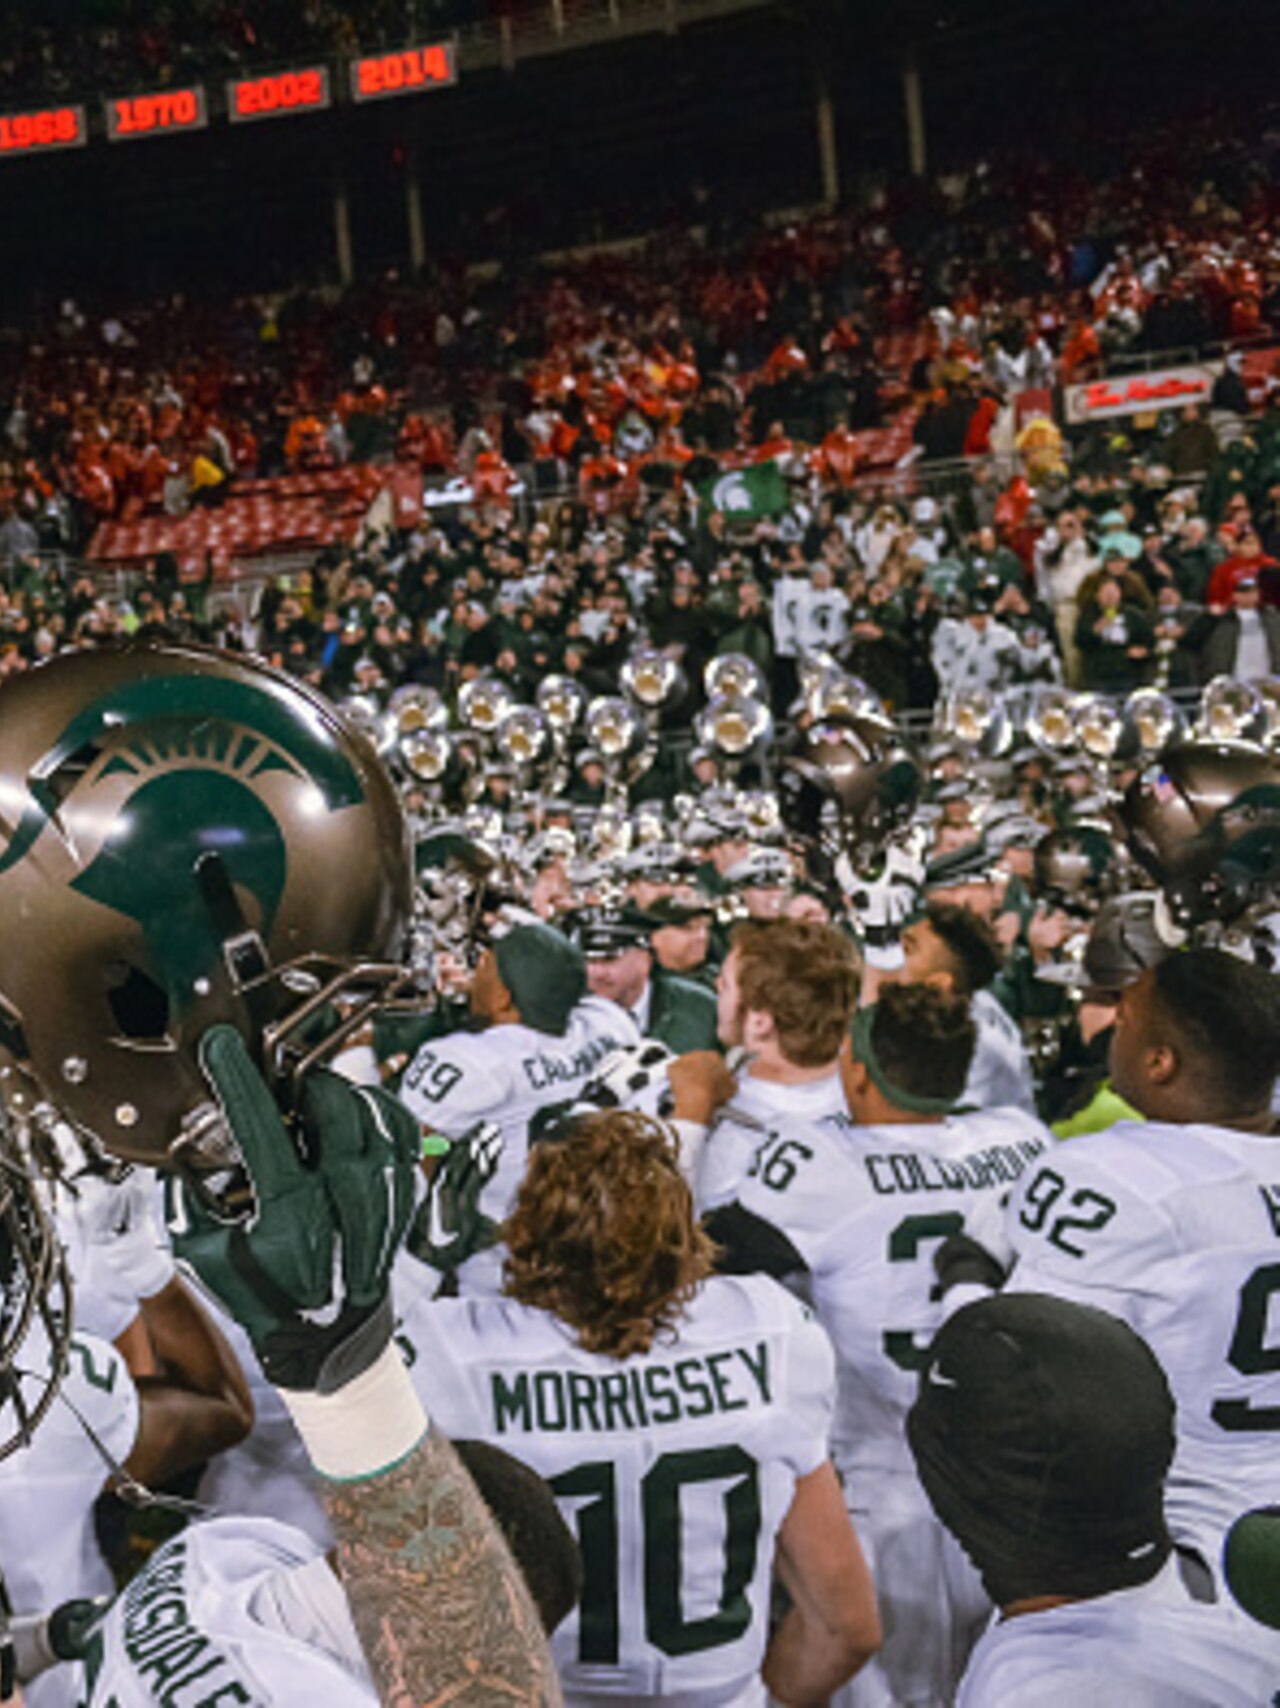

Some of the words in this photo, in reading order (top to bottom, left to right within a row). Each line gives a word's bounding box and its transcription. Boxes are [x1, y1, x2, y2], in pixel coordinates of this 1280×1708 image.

[115, 91, 198, 134] 1970
[235, 70, 322, 114] 2002
[357, 46, 450, 96] 2014
[1019, 1168, 1117, 1259] 92
[489, 1341, 774, 1435] MORRISSEY
[548, 1443, 763, 1666] 10
